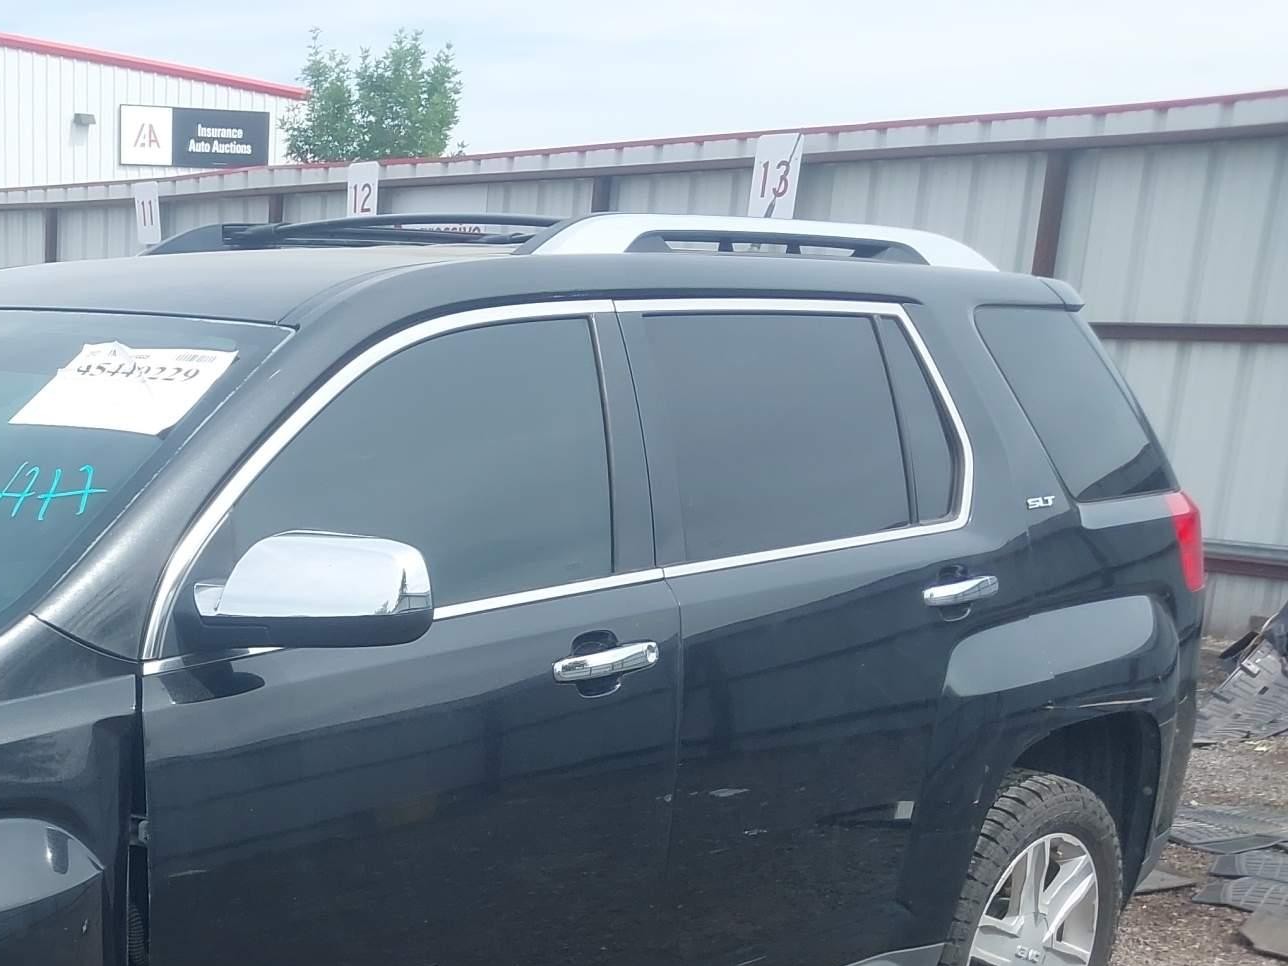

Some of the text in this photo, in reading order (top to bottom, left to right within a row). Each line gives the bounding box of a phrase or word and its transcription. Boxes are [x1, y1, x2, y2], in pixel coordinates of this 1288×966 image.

[197, 123, 244, 139] Insurance
[188, 138, 252, 155] Auto Auctions
[759, 160, 790, 198] 13
[353, 183, 372, 214] 12
[138, 199, 154, 227] 11
[1026, 495, 1056, 510] SLT
